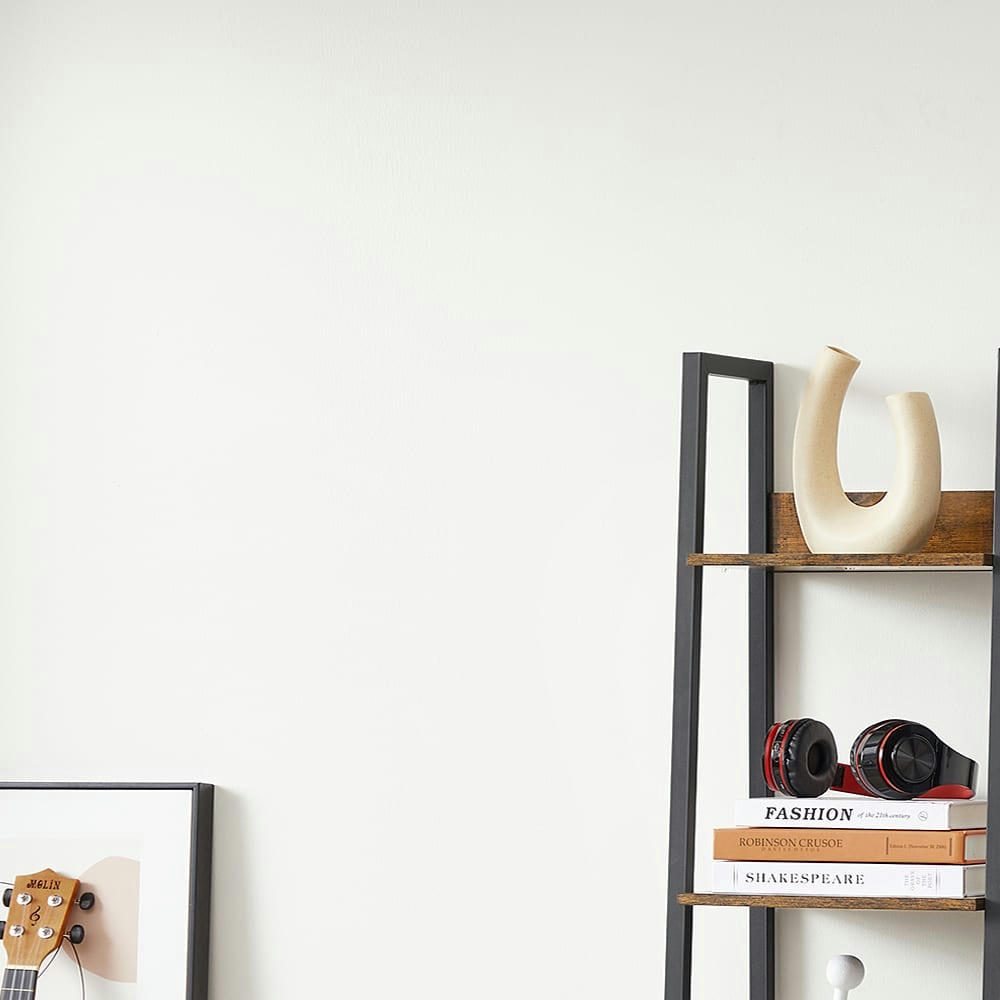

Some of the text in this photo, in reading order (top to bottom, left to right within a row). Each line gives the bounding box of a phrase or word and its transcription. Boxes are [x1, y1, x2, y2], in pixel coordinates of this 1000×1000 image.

[764, 806, 853, 821] FASHION
[739, 837, 843, 848] ROBINSON CRUSOE
[745, 872, 865, 885] SHAKESPEARE
